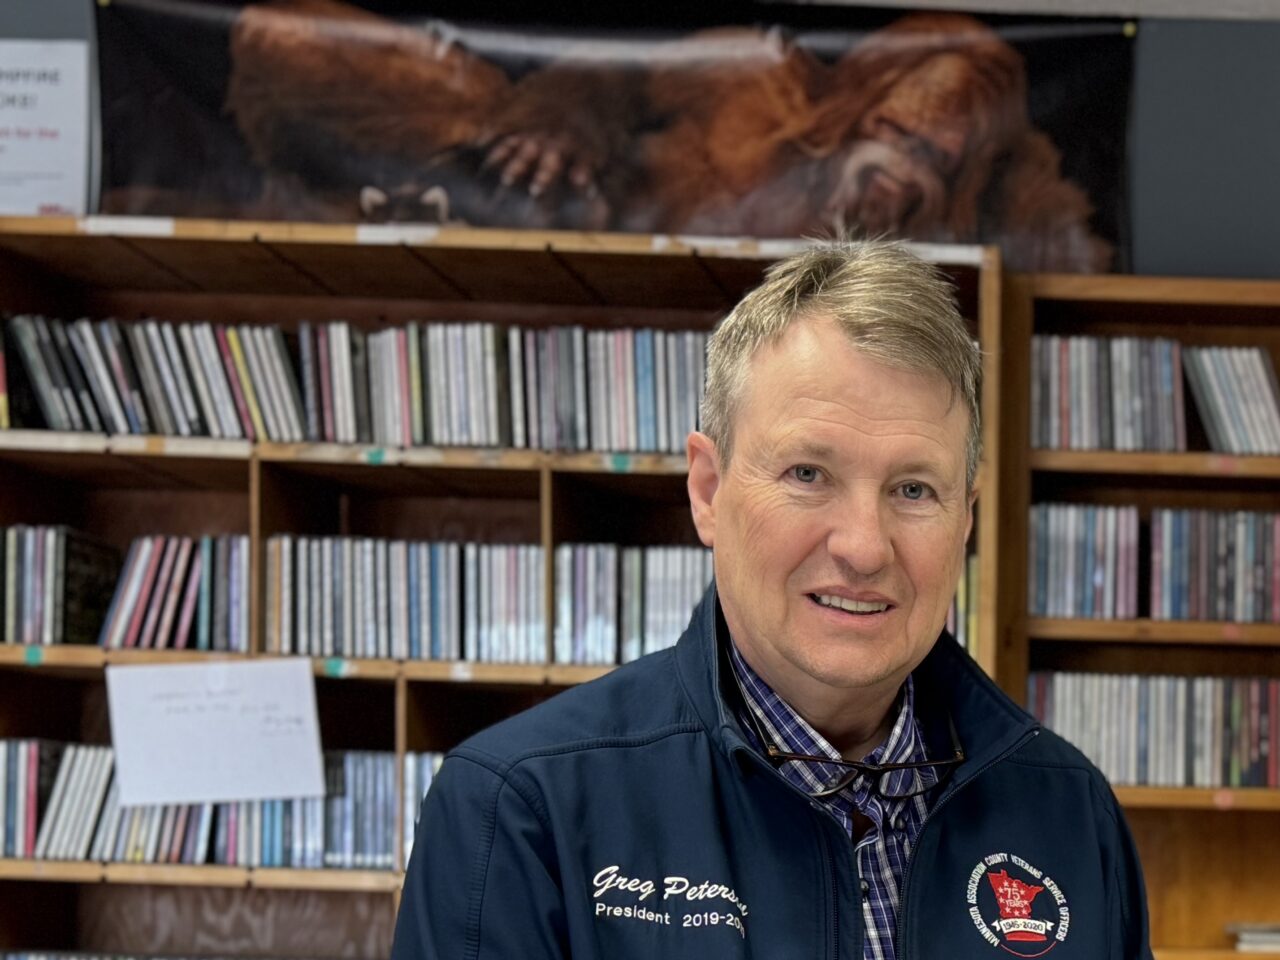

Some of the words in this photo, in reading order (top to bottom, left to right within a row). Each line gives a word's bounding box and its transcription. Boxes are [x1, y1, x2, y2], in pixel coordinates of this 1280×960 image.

[984, 853, 1009, 866] COUNTY
[1011, 854, 1043, 879] VETERANS
[593, 866, 655, 901] Greg
[966, 861, 988, 905] ASSOCIATION
[1004, 887, 1021, 901] 75
[1042, 877, 1067, 906] SERVICE
[595, 902, 670, 925] President
[1005, 899, 1025, 908] YEARS
[969, 906, 1000, 947] MINNESOTA
[1055, 906, 1070, 942] OFFICERS
